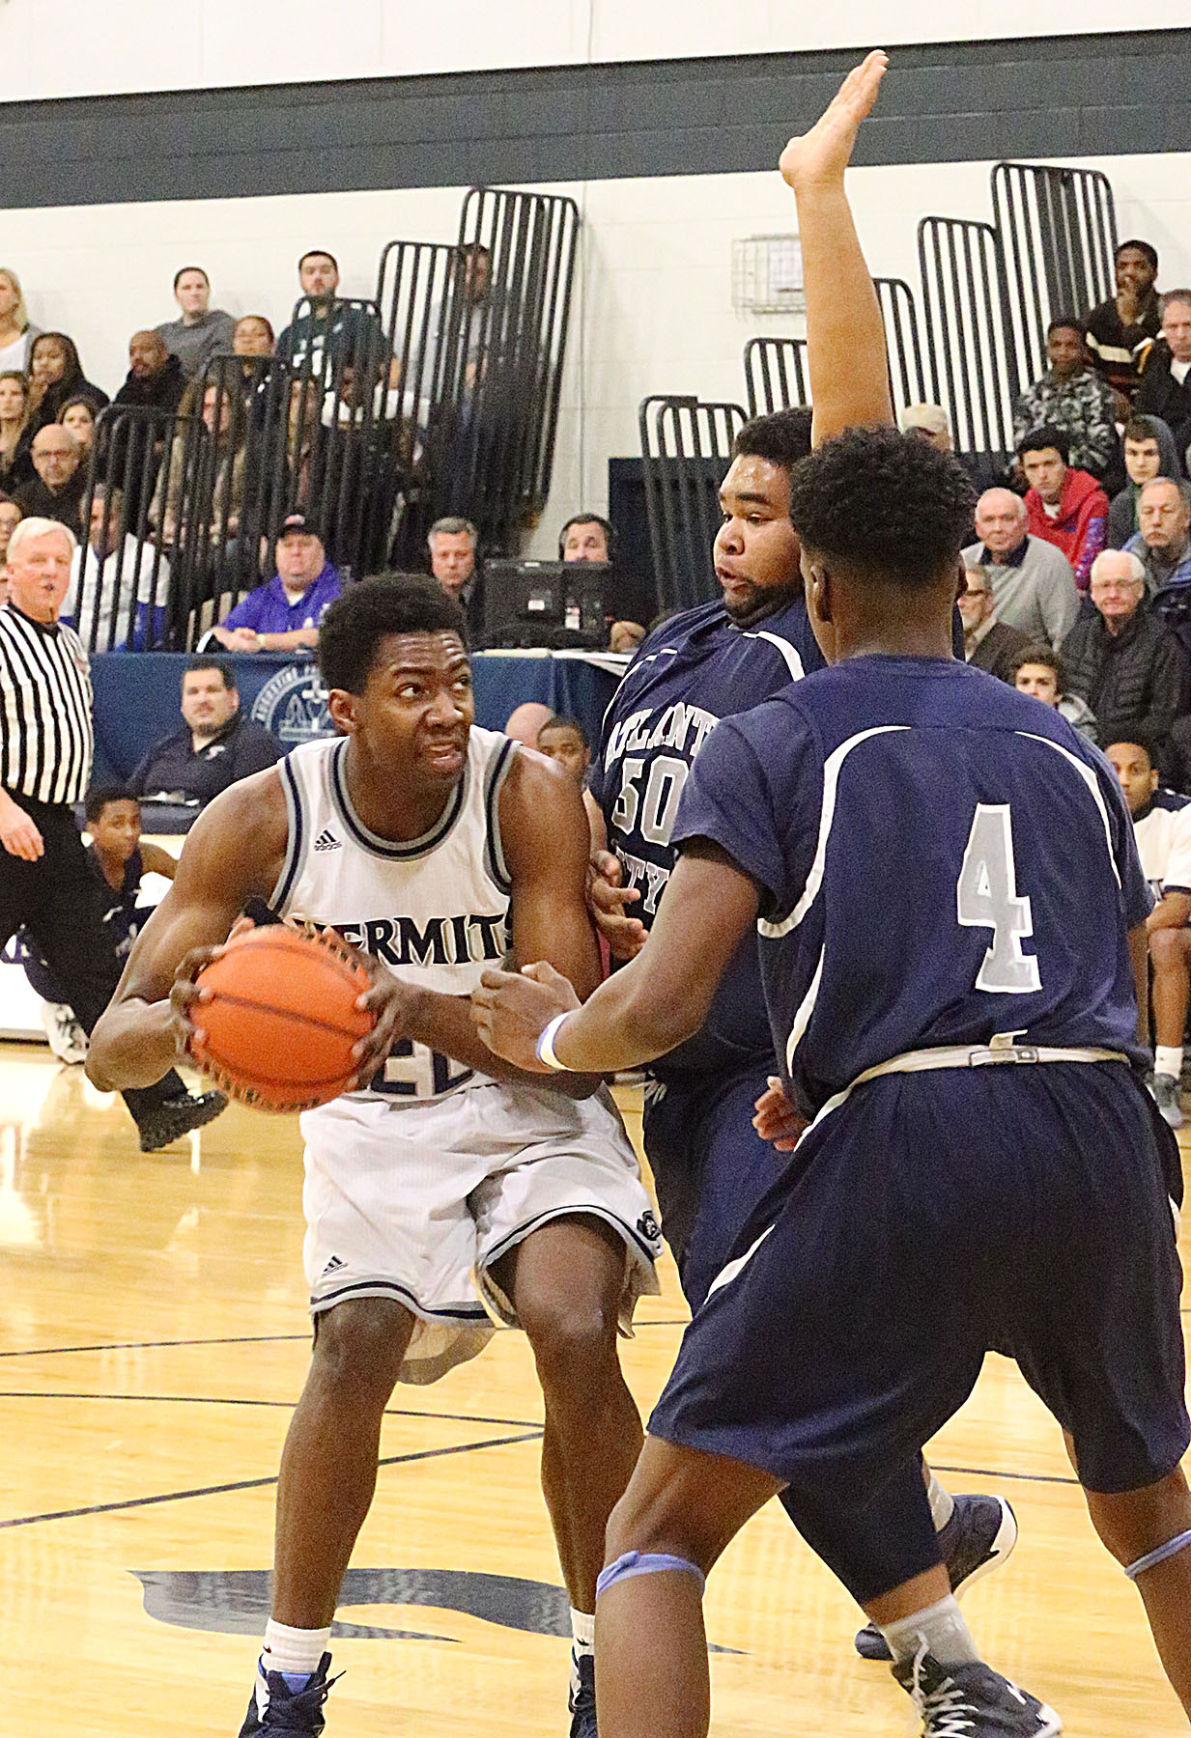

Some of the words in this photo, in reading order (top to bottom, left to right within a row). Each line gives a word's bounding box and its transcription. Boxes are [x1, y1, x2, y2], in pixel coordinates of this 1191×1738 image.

[611, 755, 690, 847] 50
[615, 845, 671, 915] TY
[957, 802, 1043, 994] 4
[291, 913, 514, 966] ERMIT
